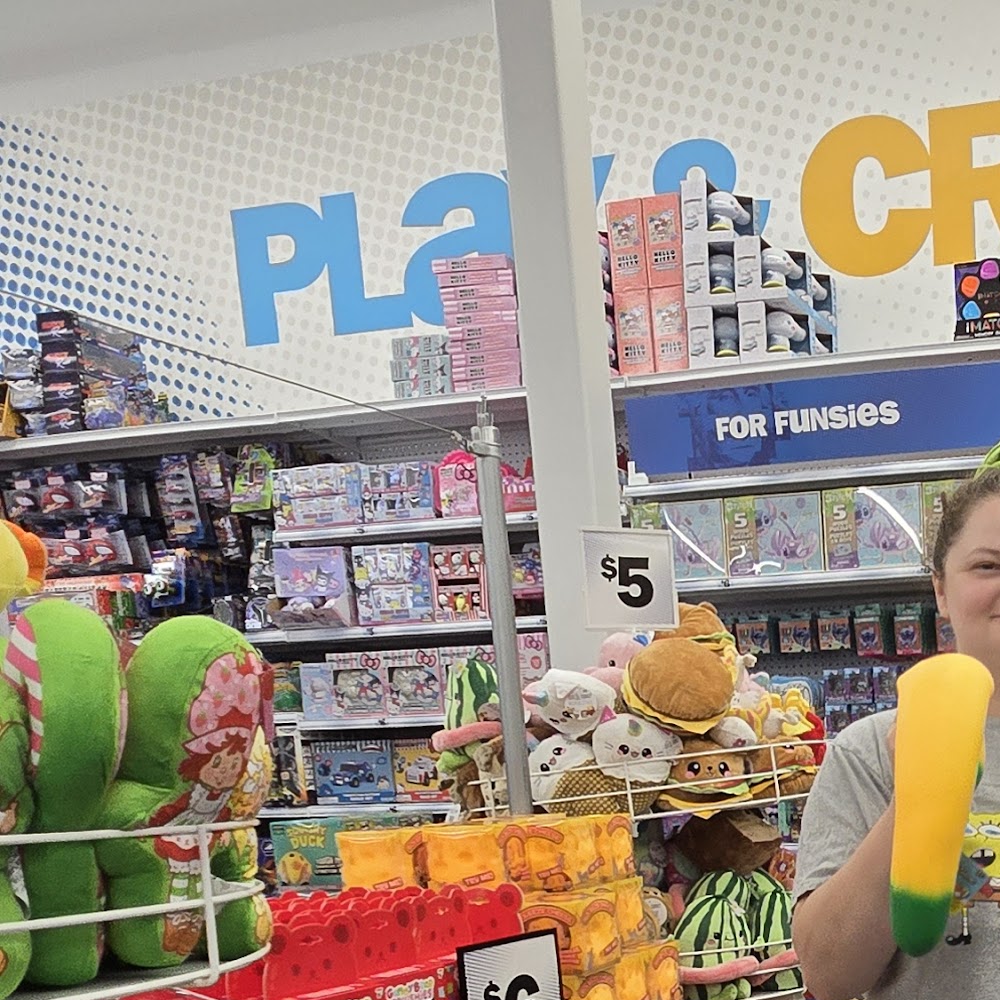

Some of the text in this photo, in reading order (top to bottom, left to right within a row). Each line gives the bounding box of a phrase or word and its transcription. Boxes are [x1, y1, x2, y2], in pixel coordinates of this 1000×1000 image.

[715, 413, 768, 442] FOR
[733, 512, 748, 529] 5
[833, 504, 847, 521] 5
[601, 554, 655, 609] $5
[290, 836, 326, 849] DUCK
